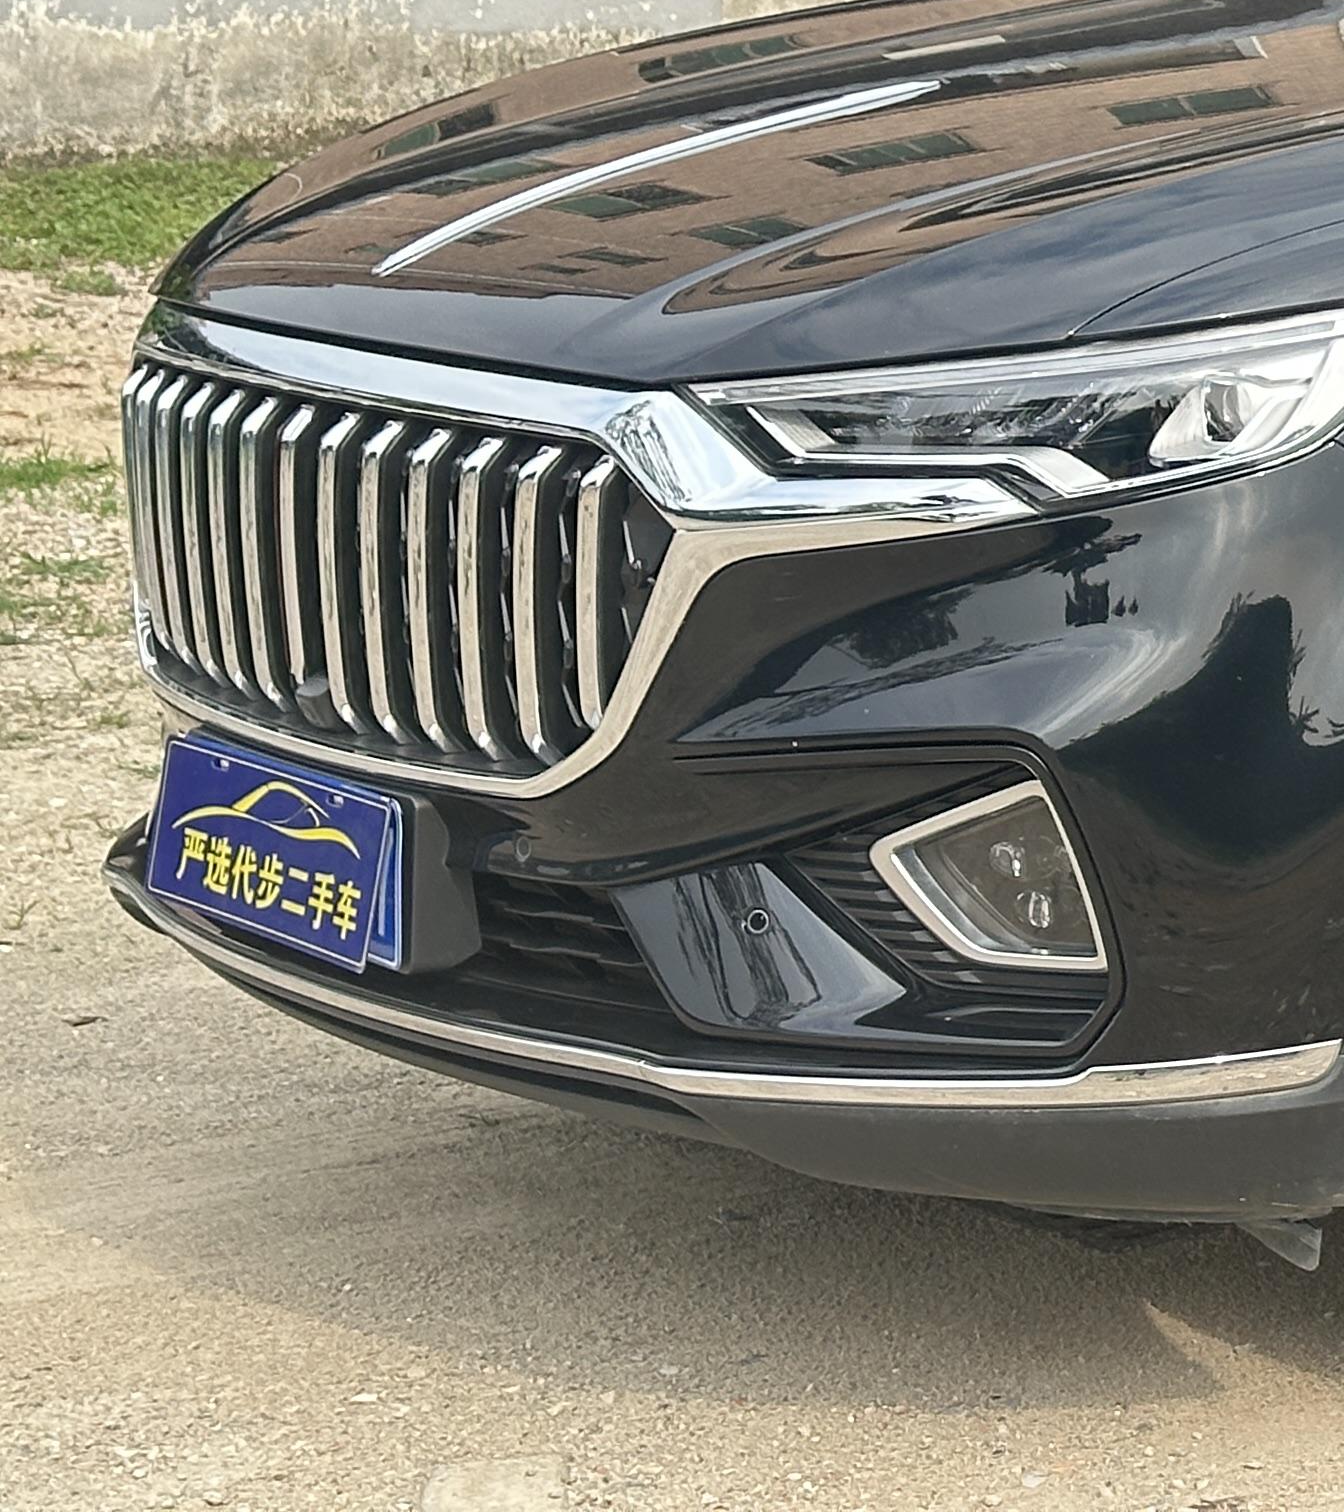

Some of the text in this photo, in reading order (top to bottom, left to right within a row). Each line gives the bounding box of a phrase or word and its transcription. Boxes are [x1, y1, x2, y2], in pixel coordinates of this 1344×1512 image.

[174, 826, 362, 941] 严选代步二手车
